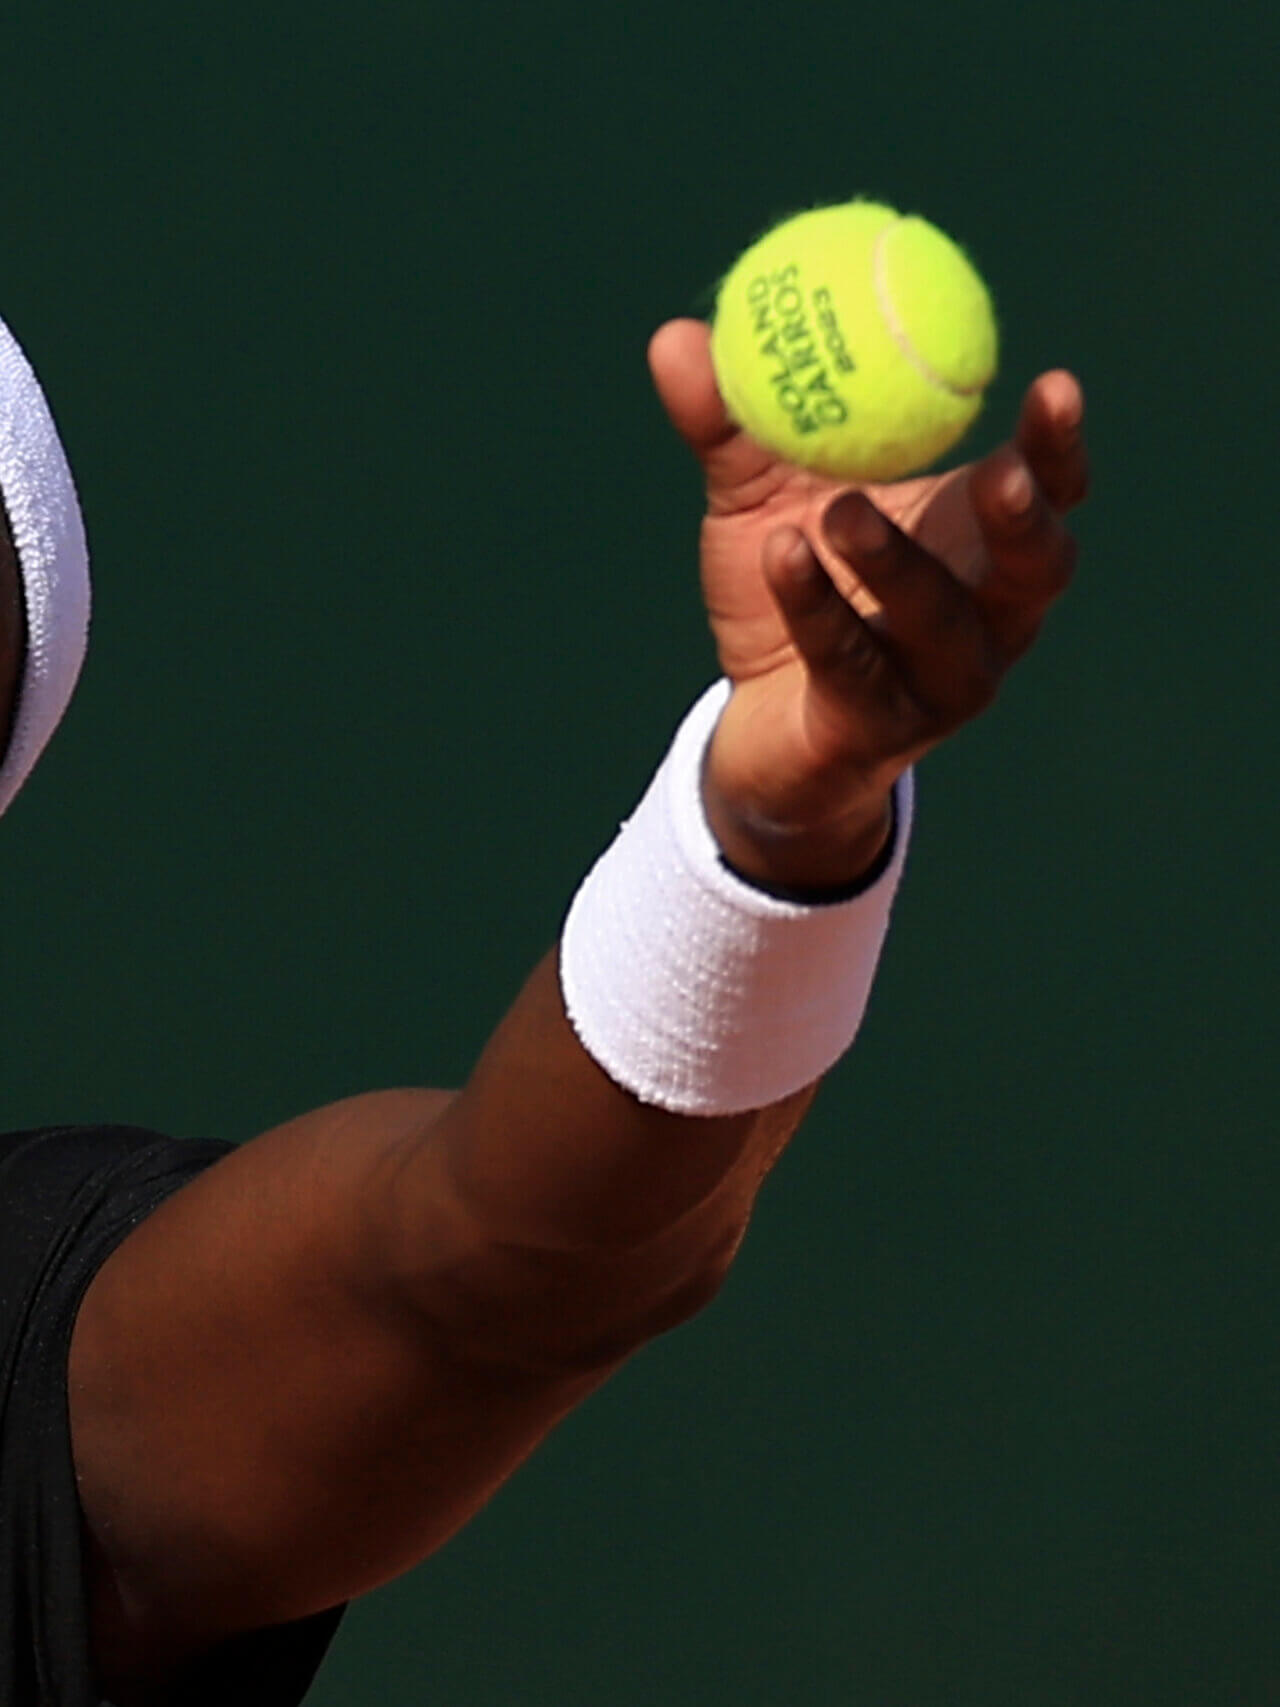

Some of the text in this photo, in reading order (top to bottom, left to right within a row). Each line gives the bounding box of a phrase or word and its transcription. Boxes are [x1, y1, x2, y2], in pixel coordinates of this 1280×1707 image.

[747, 276, 818, 435] ROLAND
[771, 265, 848, 425] GARROS
[812, 287, 857, 374] 2023
